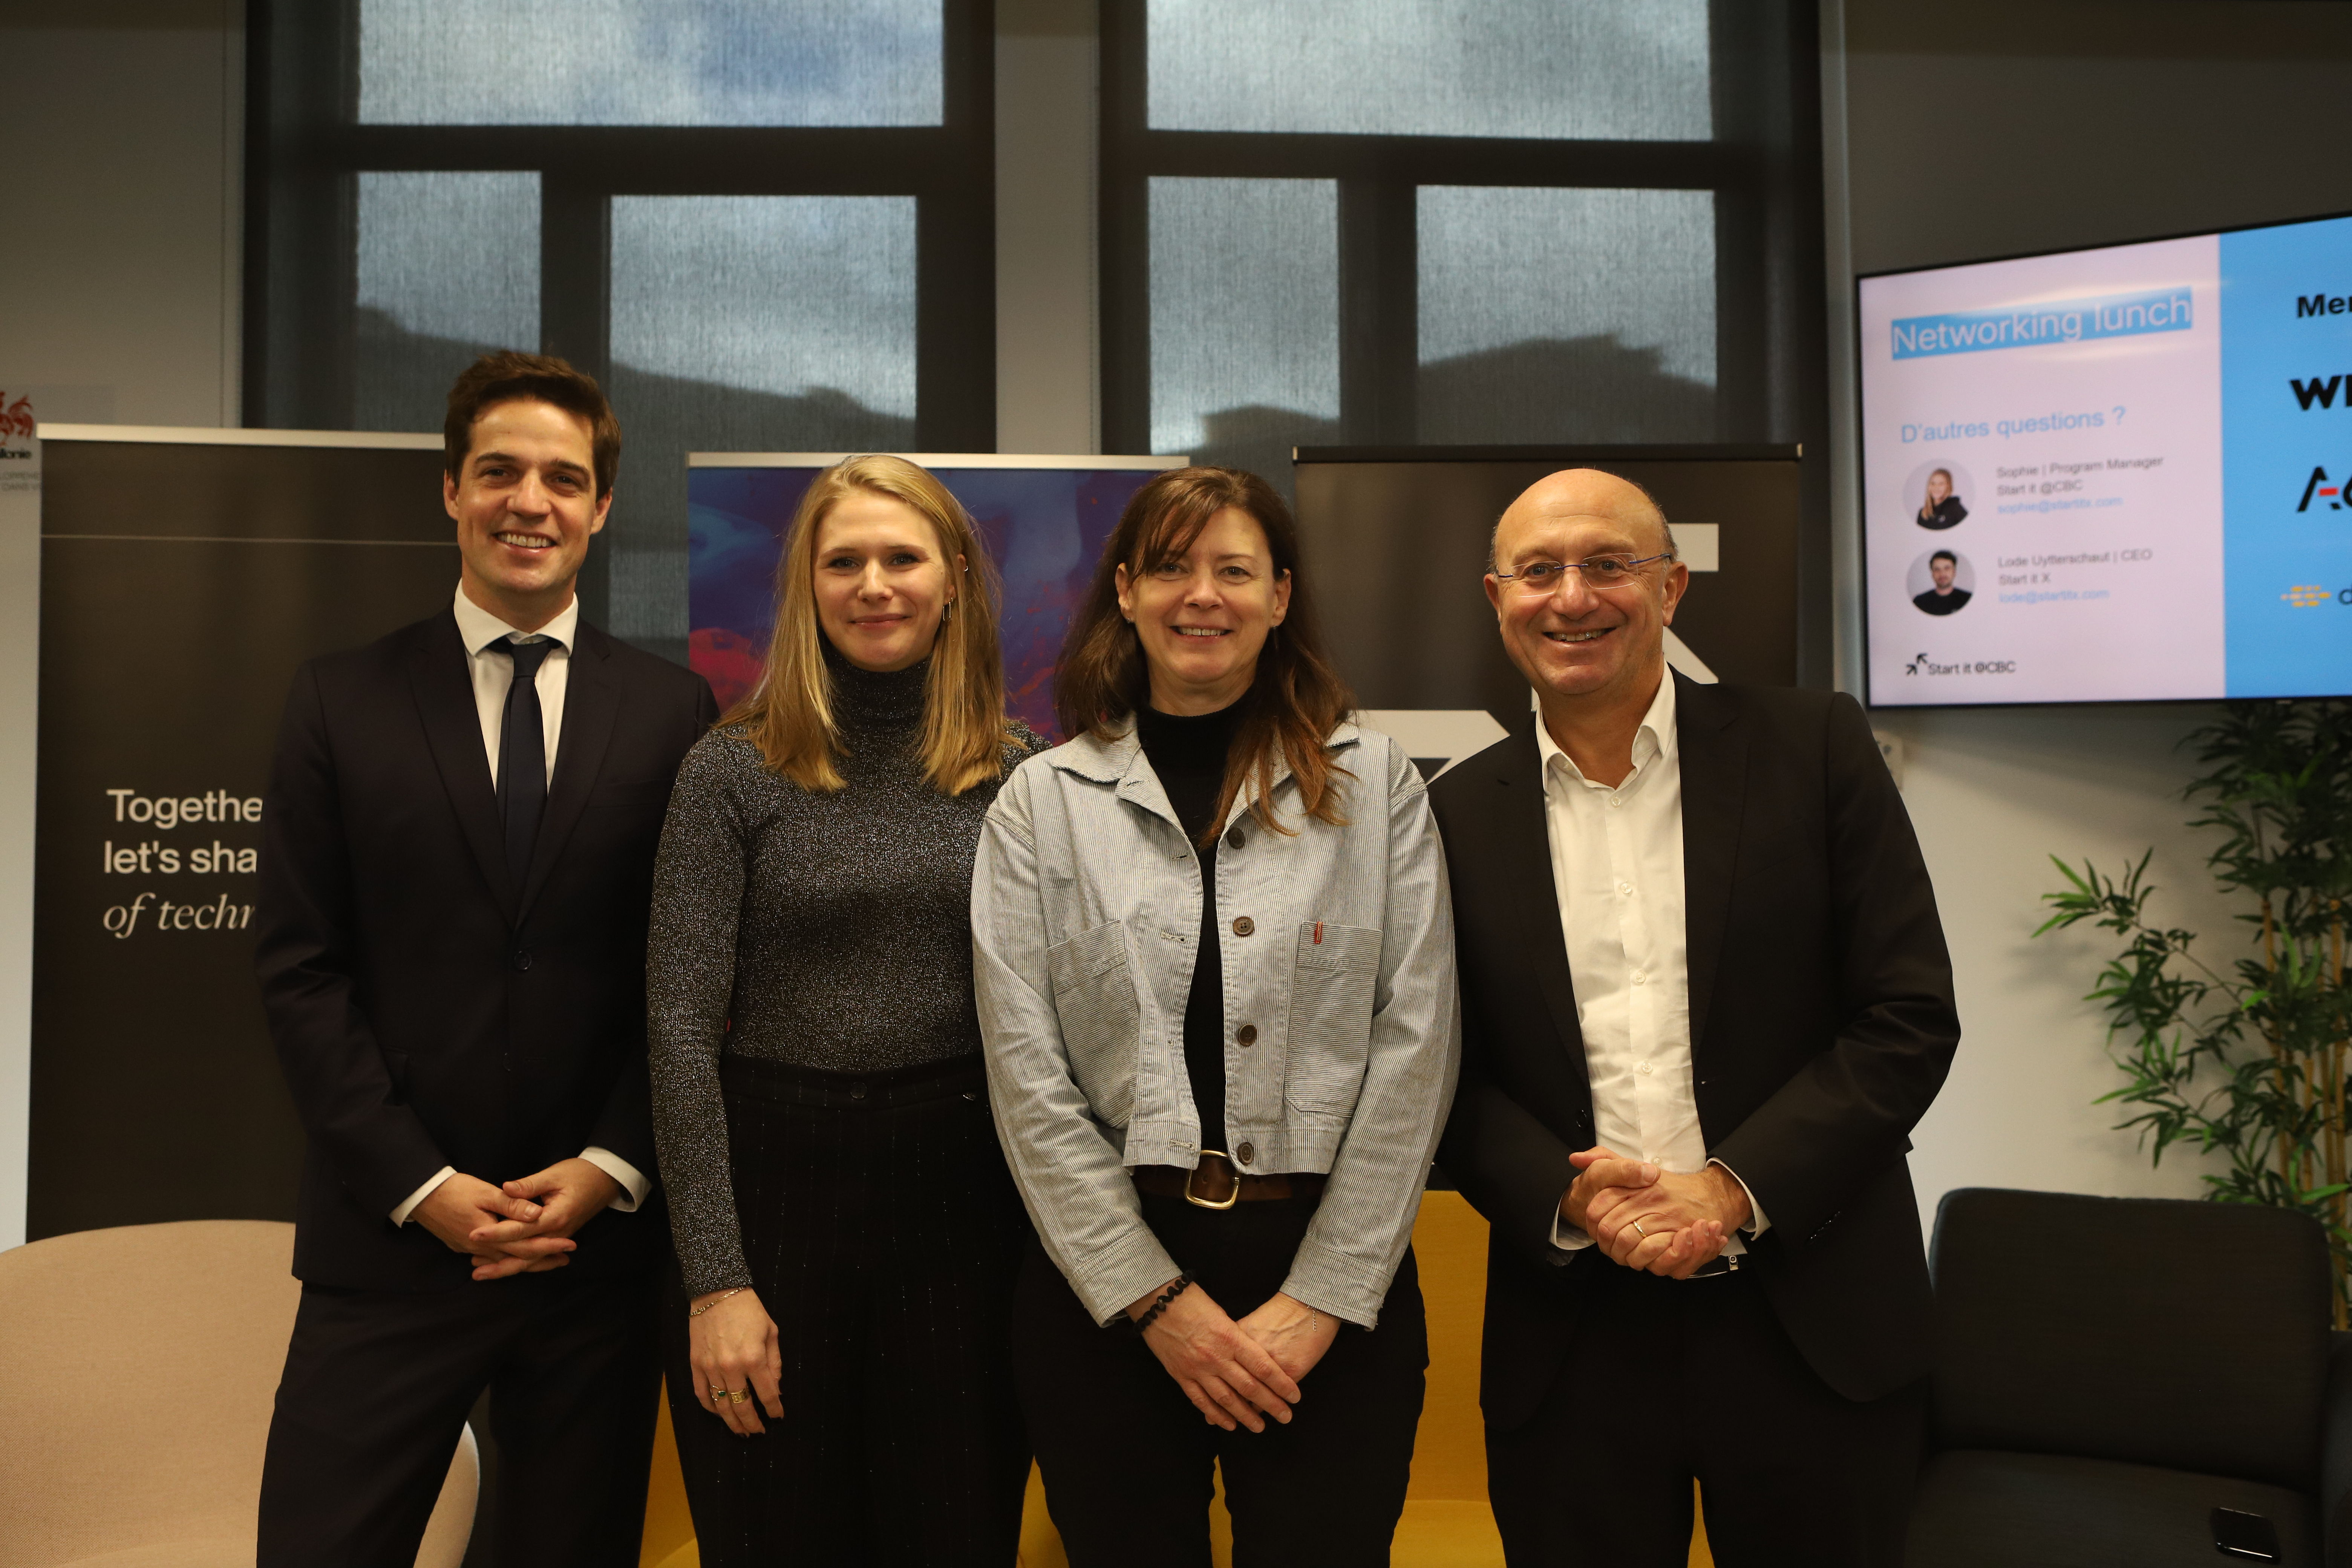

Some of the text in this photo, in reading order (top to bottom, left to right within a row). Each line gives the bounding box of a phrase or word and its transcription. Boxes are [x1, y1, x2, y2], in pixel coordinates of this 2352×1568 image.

[1893, 295, 2191, 354] Networking lunch
[1901, 406, 2126, 444] D'autres questions ?
[1997, 466, 2039, 479] Sophie
[2049, 461, 2104, 476] Program
[2106, 457, 2164, 470] Manager
[1997, 479, 2083, 496] Start it @CBC
[1998, 556, 2029, 568] Lode
[2120, 548, 2153, 562] CEO
[1998, 573, 2051, 586] Start it X
[1928, 660, 2017, 676] Start it @CBC
[106, 789, 263, 830] Togethe
[104, 840, 257, 874] let's sha
[103, 892, 156, 939] of
